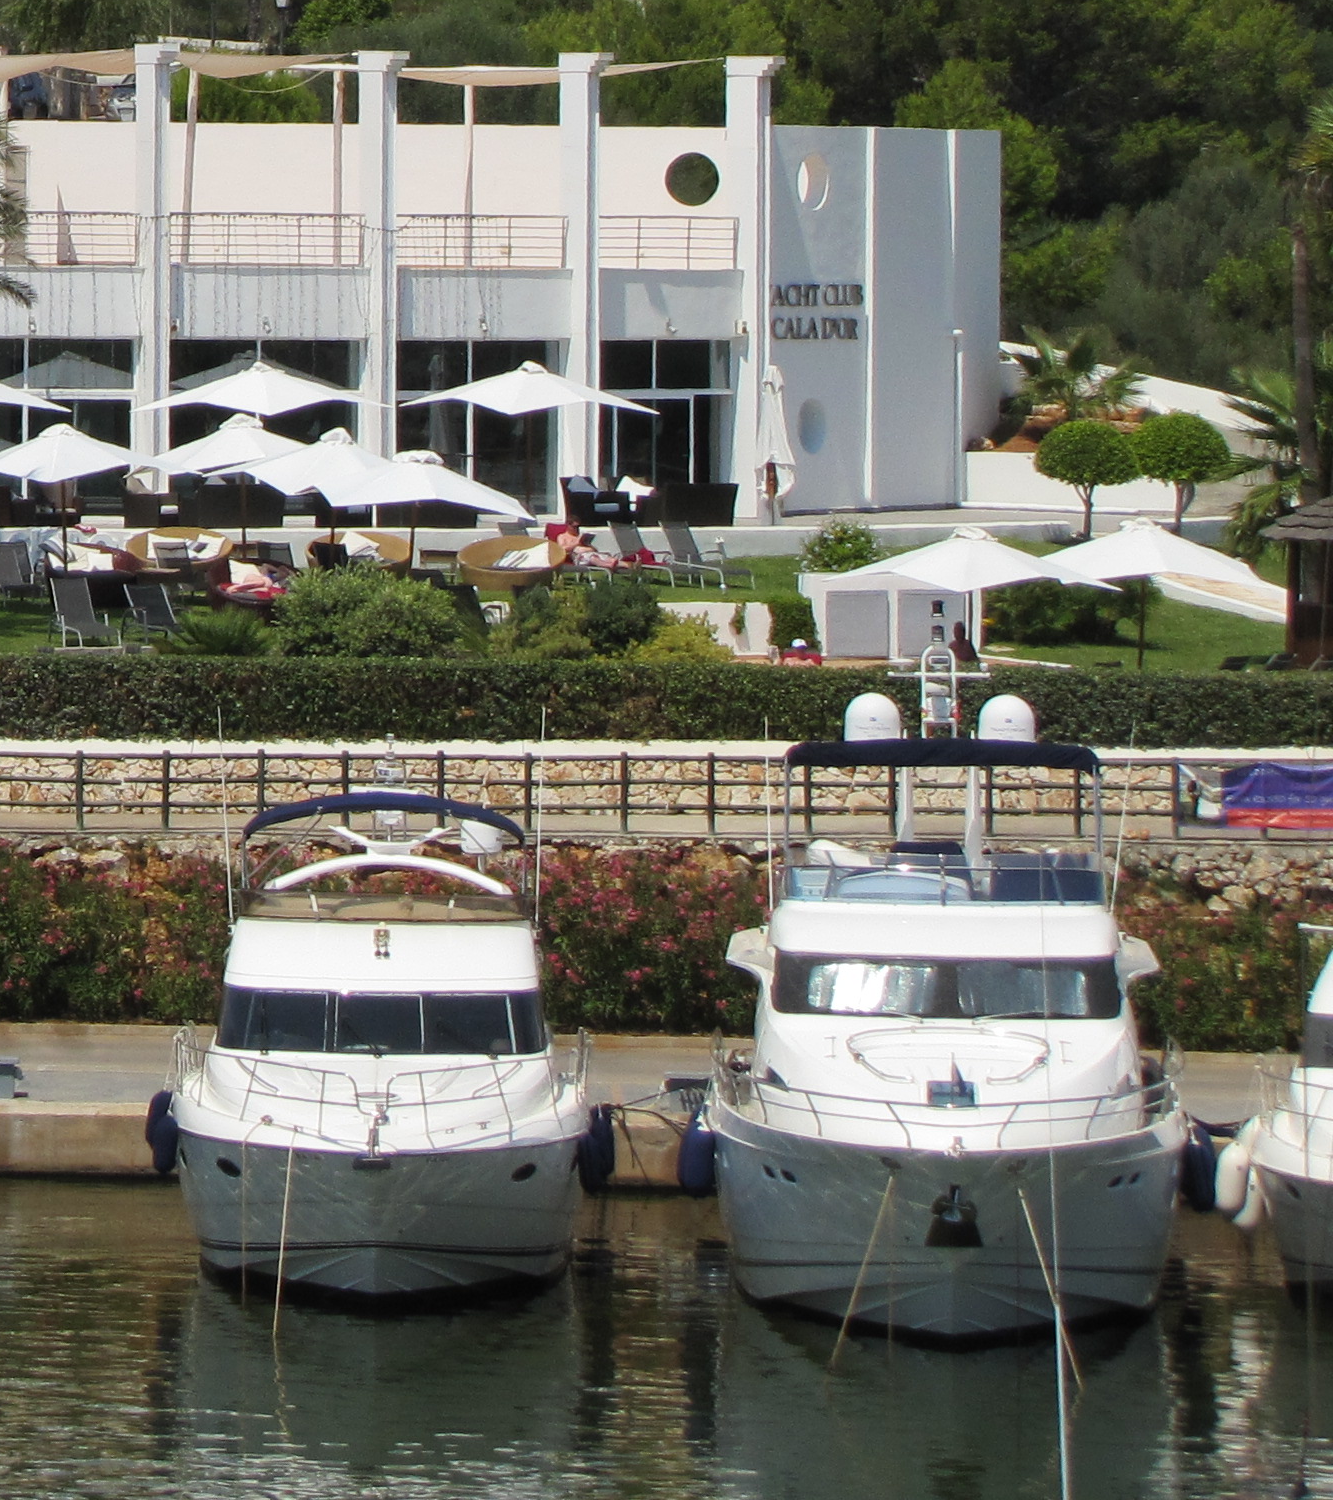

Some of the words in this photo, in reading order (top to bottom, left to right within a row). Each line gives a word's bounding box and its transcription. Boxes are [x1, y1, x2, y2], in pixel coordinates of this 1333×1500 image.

[770, 284, 820, 306] ACHT
[822, 284, 864, 306] CLUB
[771, 317, 819, 340] CALA
